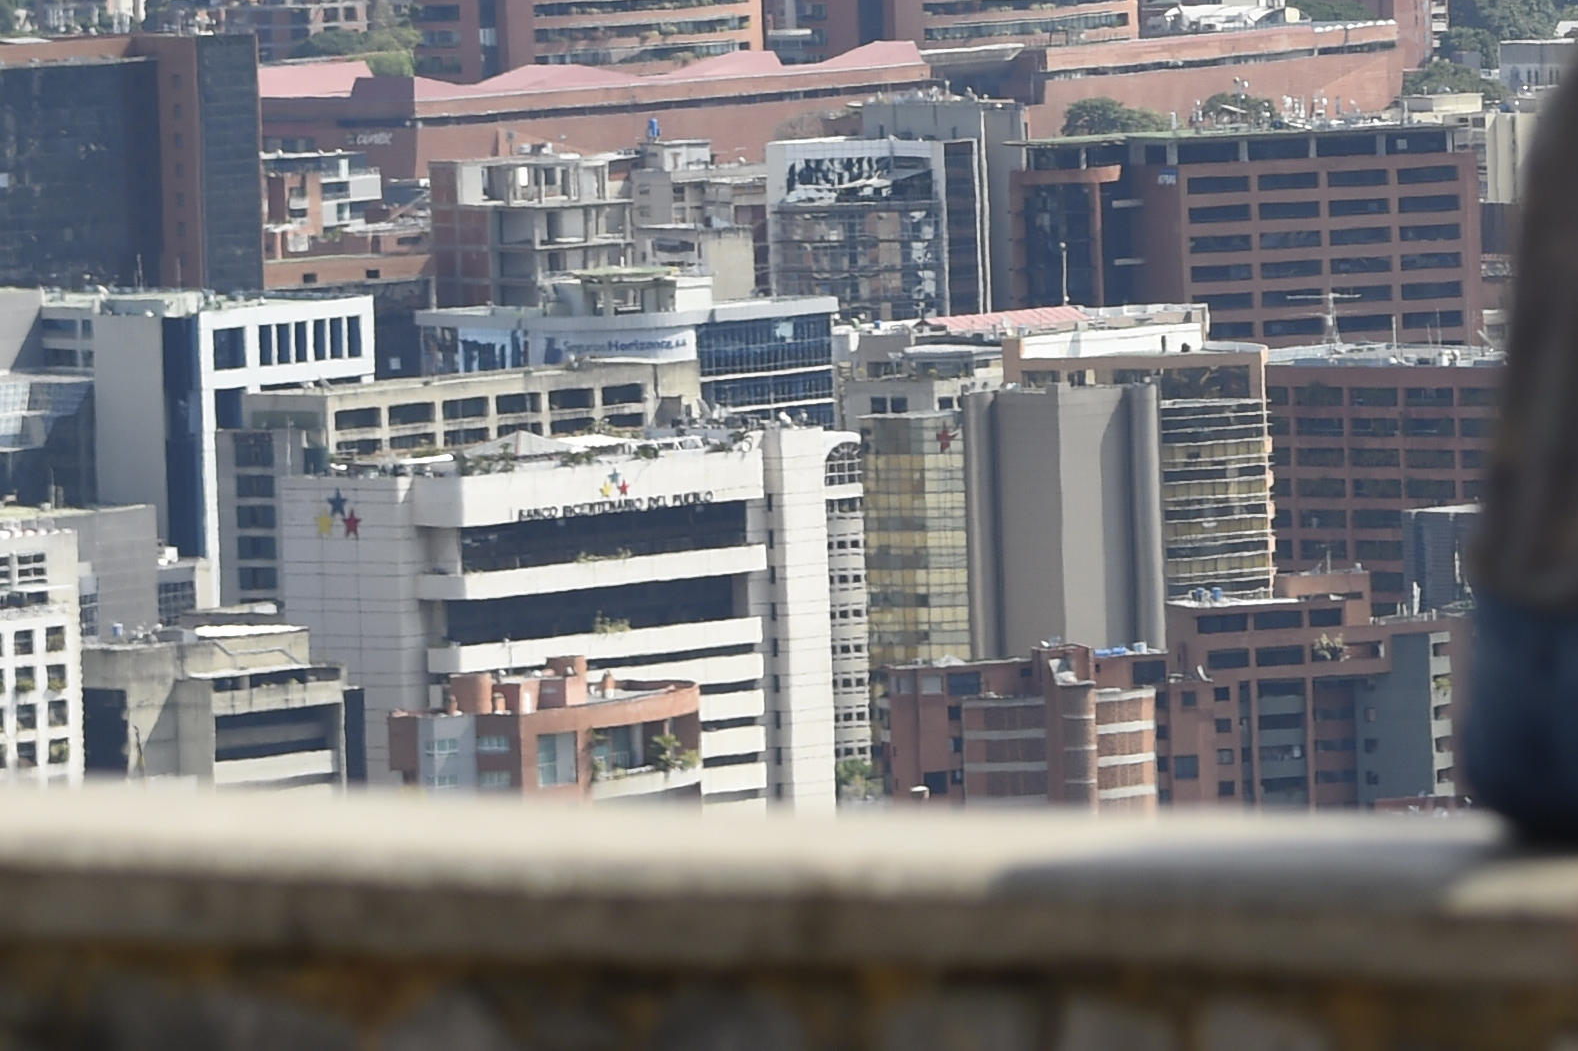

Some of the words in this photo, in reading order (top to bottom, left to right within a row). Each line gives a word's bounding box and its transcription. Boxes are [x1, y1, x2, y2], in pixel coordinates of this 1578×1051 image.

[517, 507, 559, 522] BANCO
[562, 497, 644, 518] BICENTENARIO
[647, 496, 666, 510] DEL
[672, 491, 714, 505] PUEBLO
